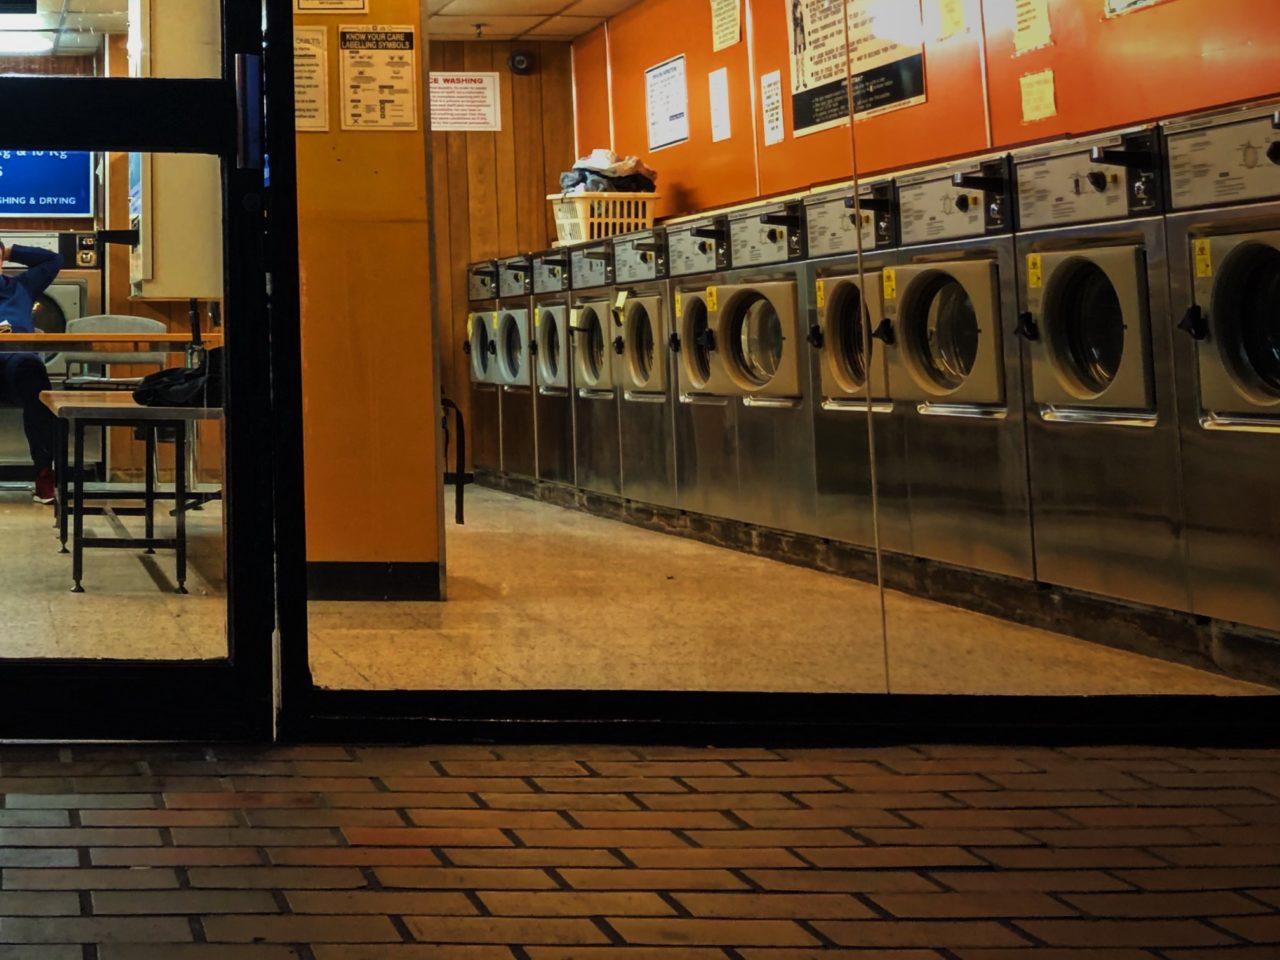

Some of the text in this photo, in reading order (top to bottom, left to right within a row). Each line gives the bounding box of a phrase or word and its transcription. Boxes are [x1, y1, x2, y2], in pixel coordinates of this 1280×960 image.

[345, 33, 405, 42] KNOW YOUR CARE
[341, 41, 410, 50] LABELLING SYMBOLS
[442, 77, 484, 85] WASHING
[29, 197, 36, 205] &
[39, 197, 77, 205] DRYING
